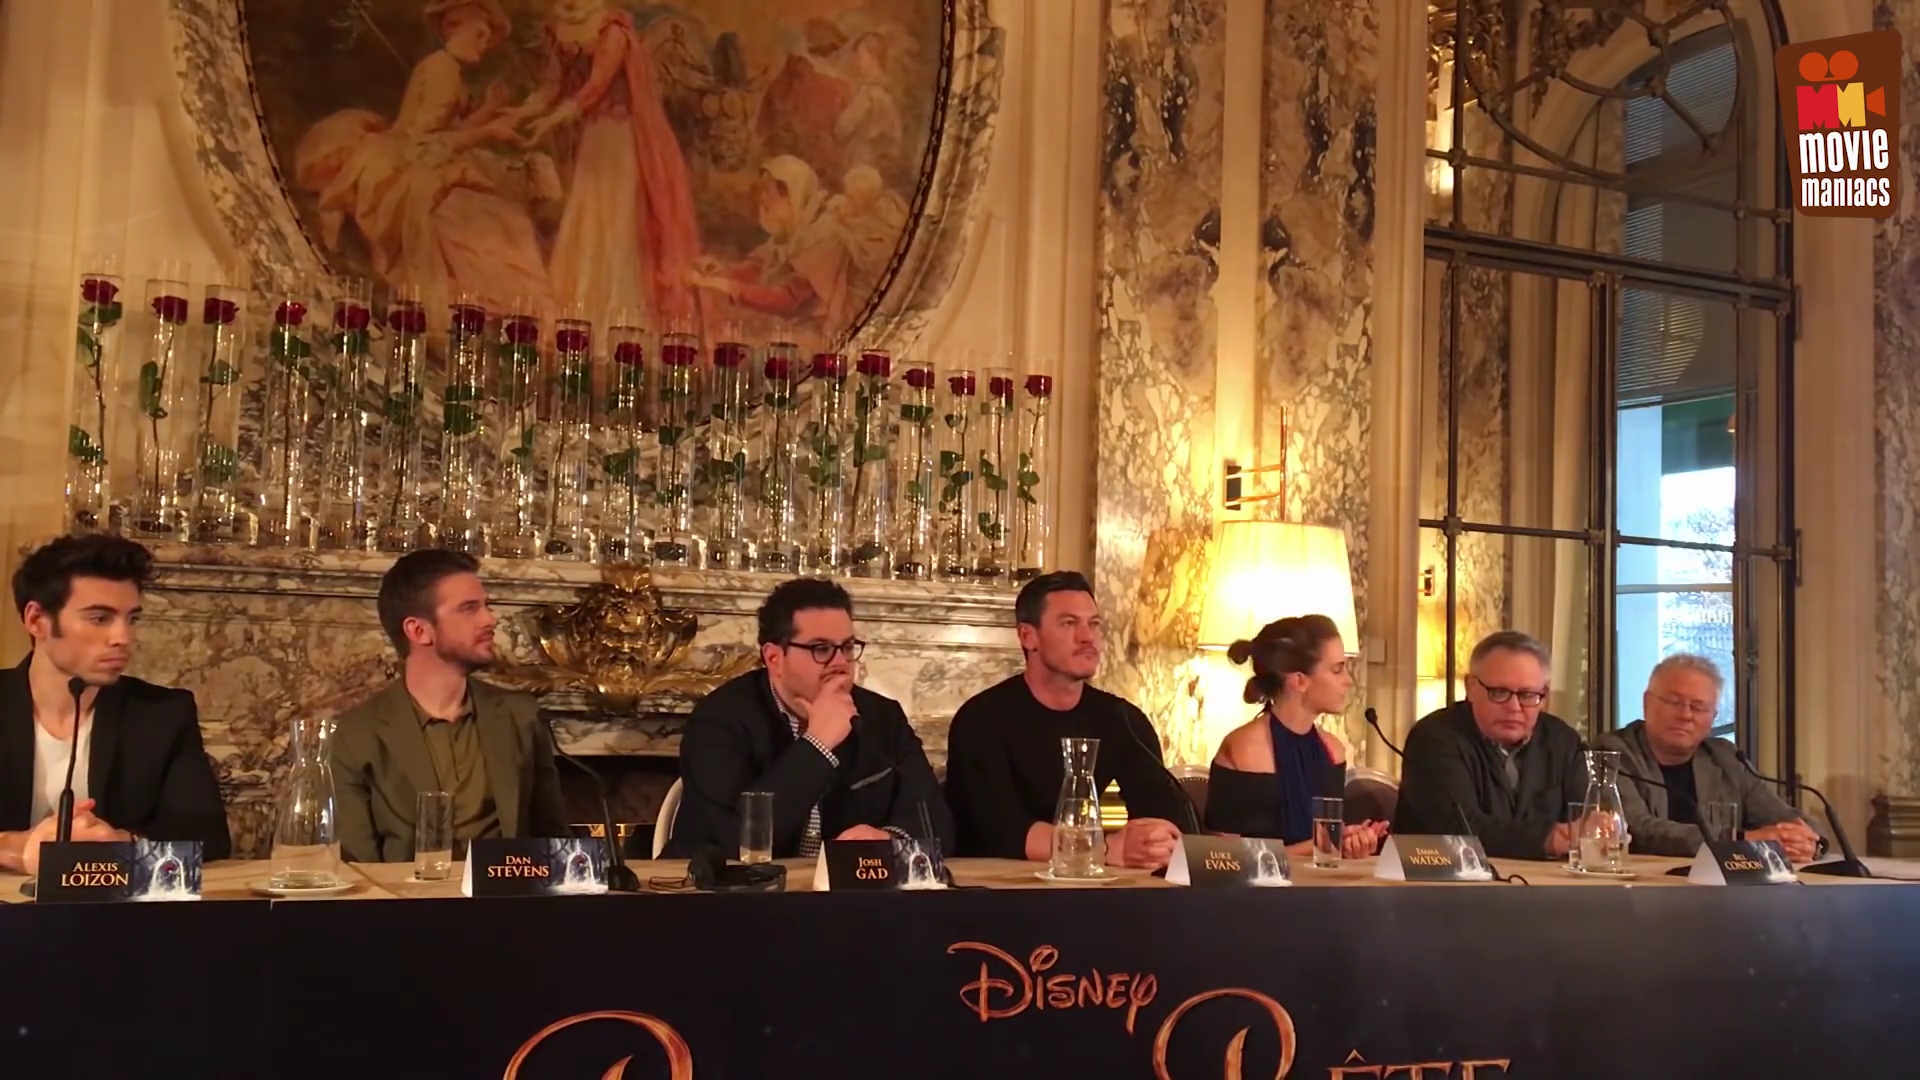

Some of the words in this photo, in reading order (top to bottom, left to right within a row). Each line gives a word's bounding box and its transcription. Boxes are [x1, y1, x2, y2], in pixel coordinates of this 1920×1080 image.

[505, 855, 531, 865] DAN
[858, 857, 882, 868] JOSH
[1205, 859, 1241, 871] EVANS
[1409, 855, 1452, 866] WATSON
[1724, 860, 1764, 871] CONDON
[73, 861, 119, 872] ALEXIS
[487, 865, 550, 877] STEVENS
[855, 867, 889, 880] GAD
[61, 873, 129, 886] LOIZON
